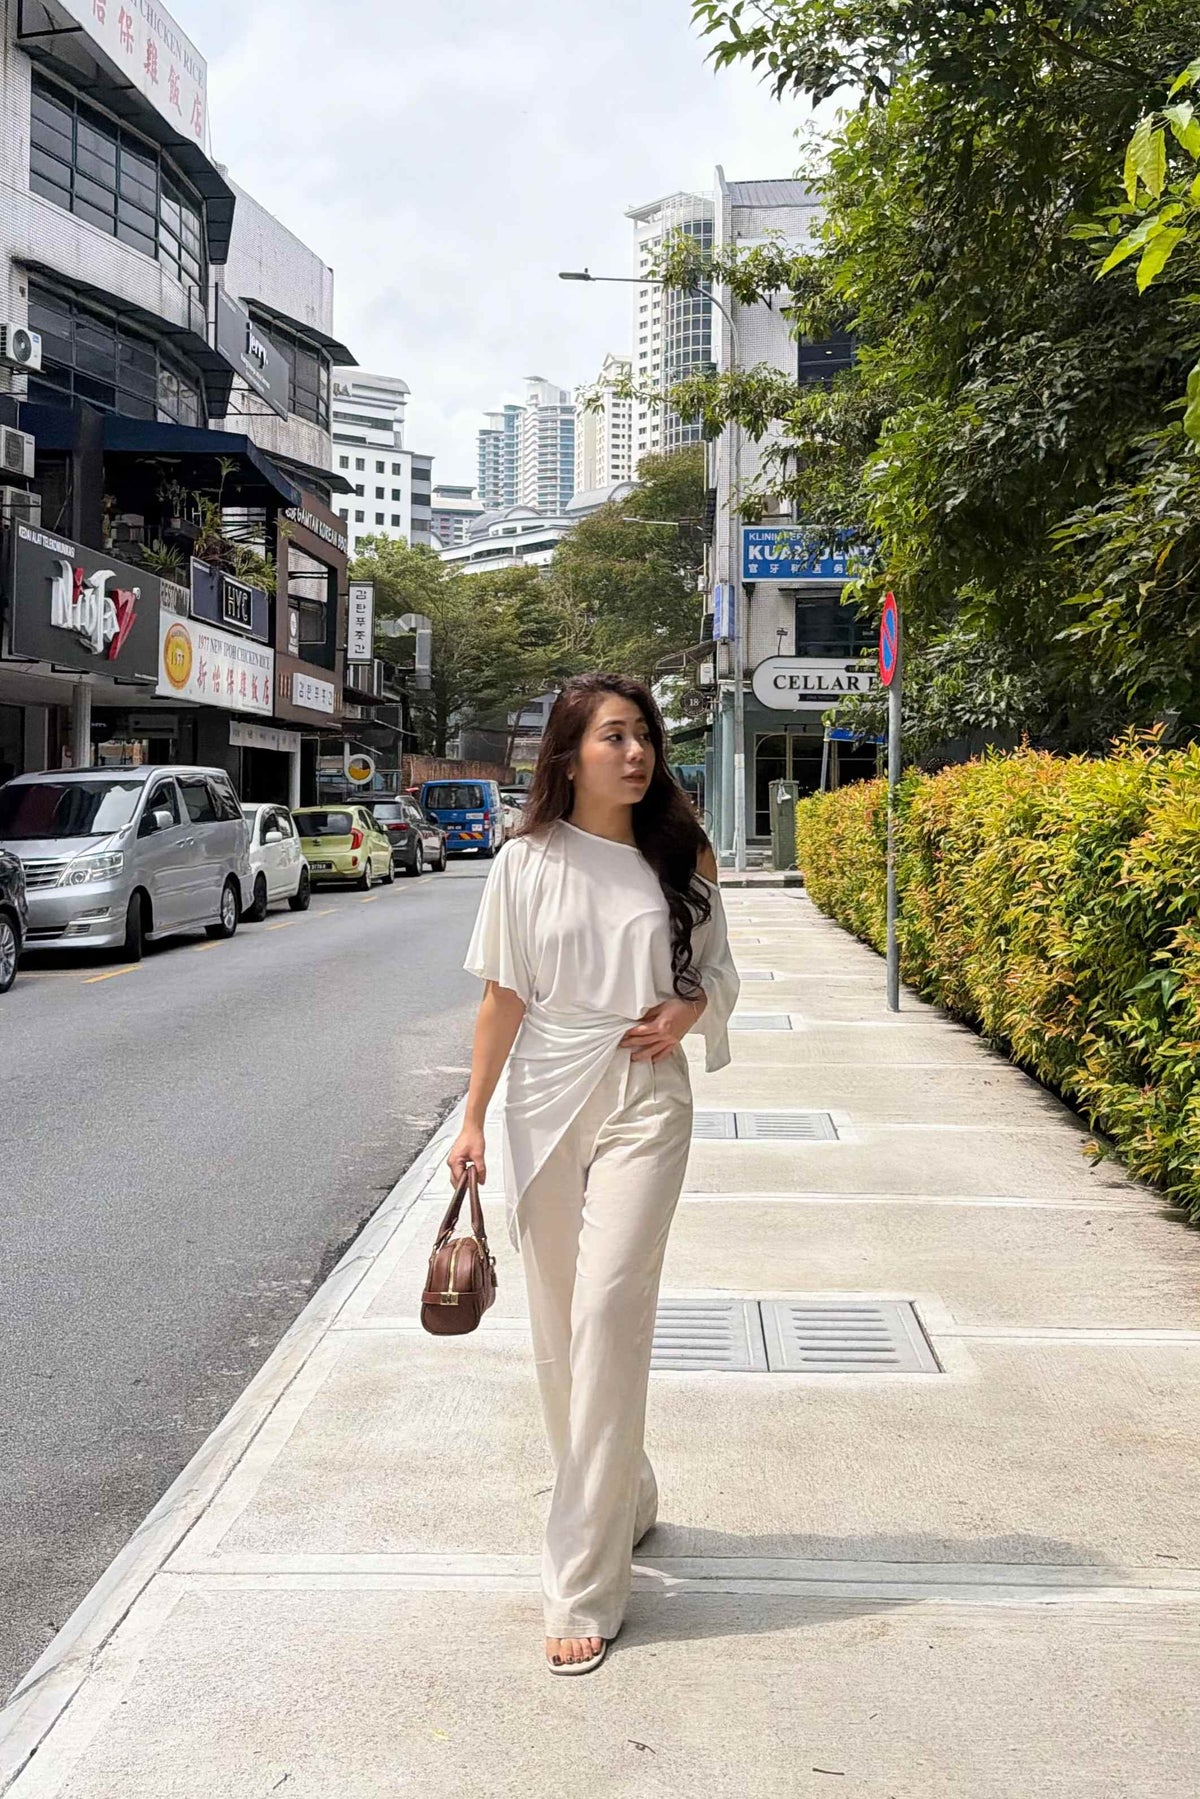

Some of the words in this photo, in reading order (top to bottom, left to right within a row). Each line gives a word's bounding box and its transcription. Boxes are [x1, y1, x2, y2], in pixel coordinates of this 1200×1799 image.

[183, 48, 204, 90] RICE
[748, 532, 780, 541] KLINI
[773, 675, 860, 691] CELLAR
[689, 698, 700, 707] 18
